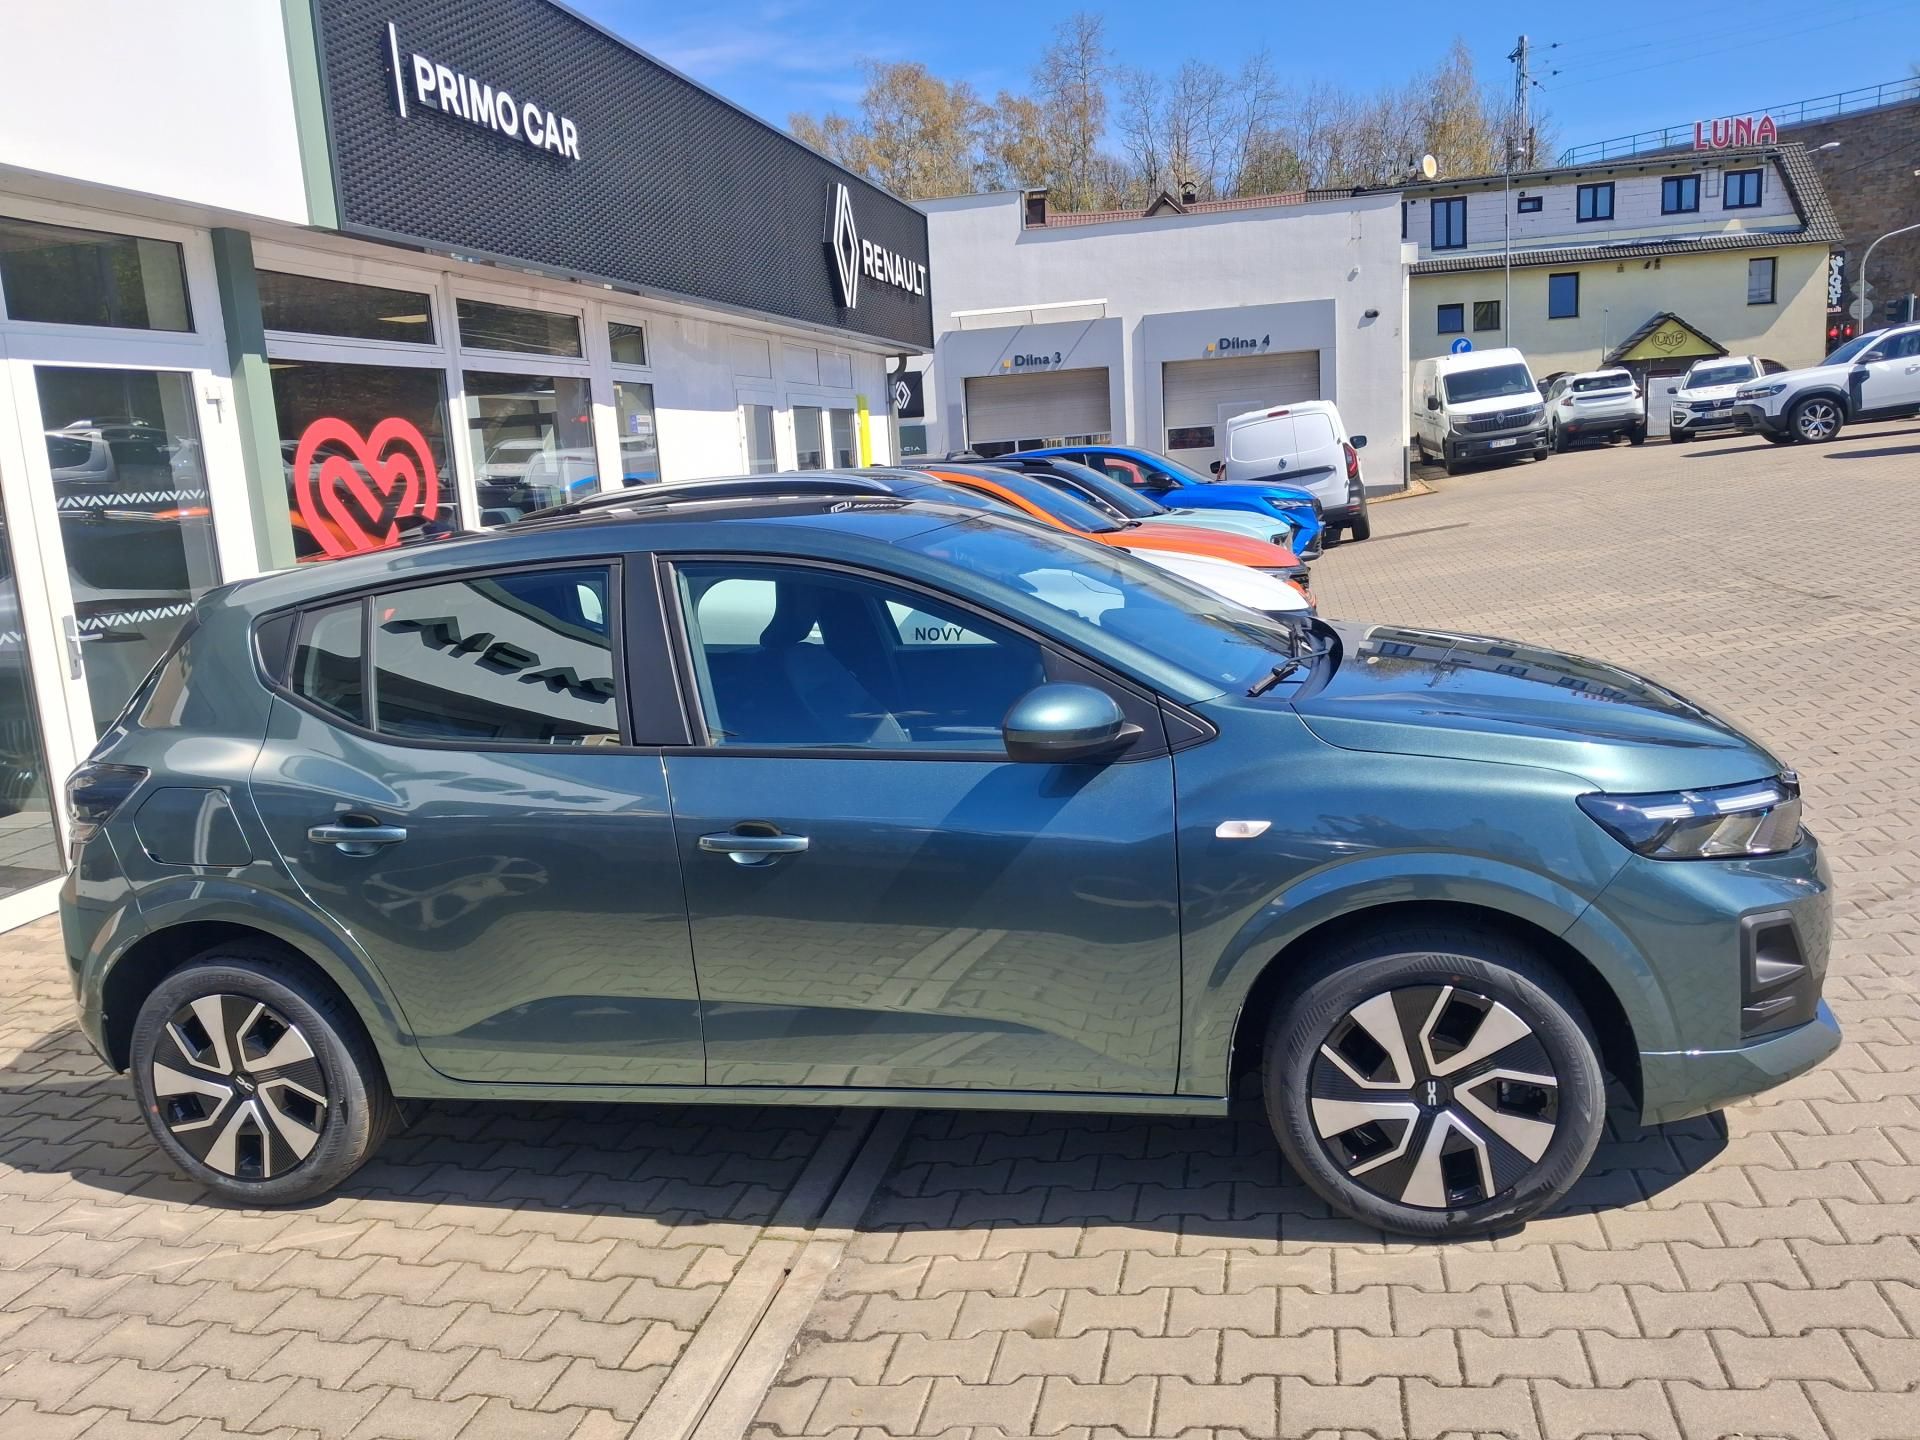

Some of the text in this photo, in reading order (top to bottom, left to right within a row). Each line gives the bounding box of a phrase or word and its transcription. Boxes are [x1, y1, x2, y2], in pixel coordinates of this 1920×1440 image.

[412, 53, 581, 160] PRIMO CAR
[1693, 113, 1778, 150] LUNA
[862, 238, 926, 297] RENAULT
[1054, 351, 1062, 364] 3
[1262, 333, 1271, 347] 4
